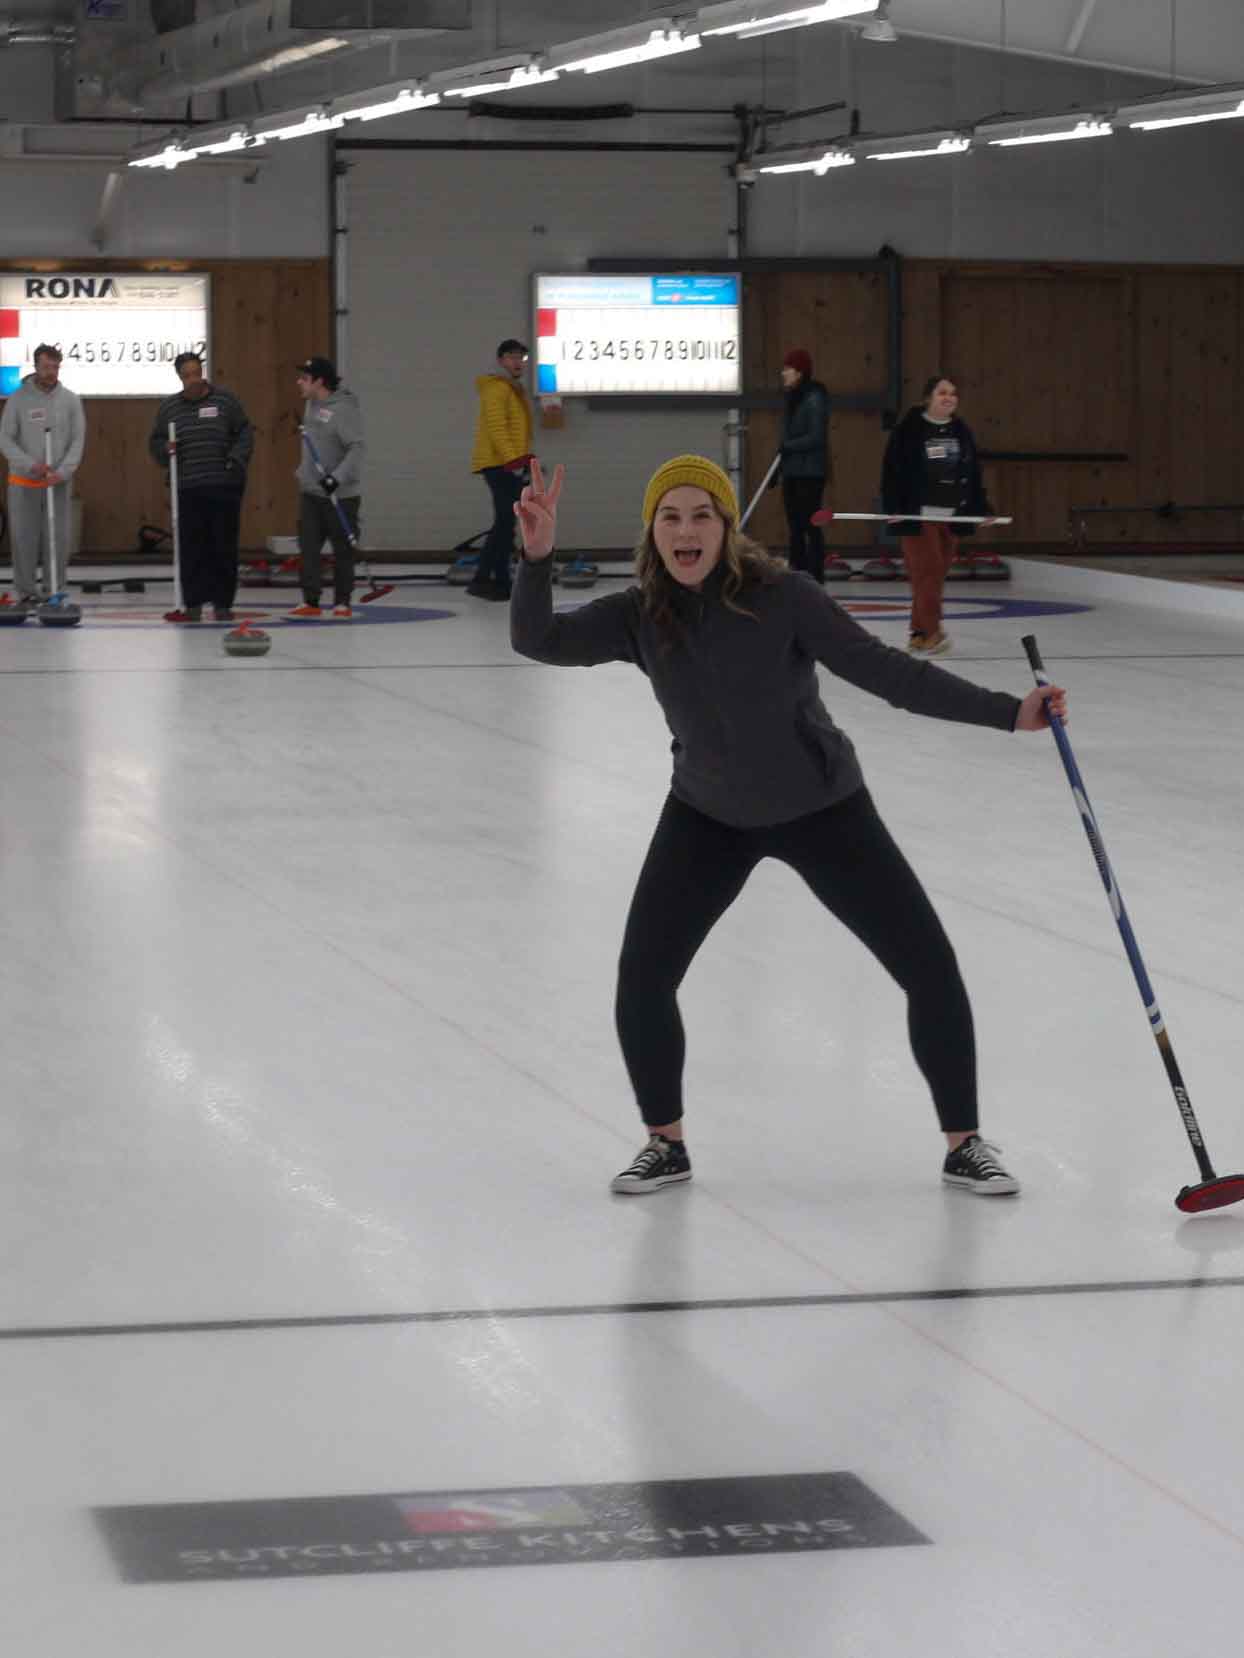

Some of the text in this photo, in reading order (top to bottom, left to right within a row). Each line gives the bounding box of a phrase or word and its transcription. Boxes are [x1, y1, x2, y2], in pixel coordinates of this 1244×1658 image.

[25, 278, 120, 298] RONA
[178, 1536, 505, 1563] SUTCLIFFE
[517, 1518, 853, 1547] KITCHENS
